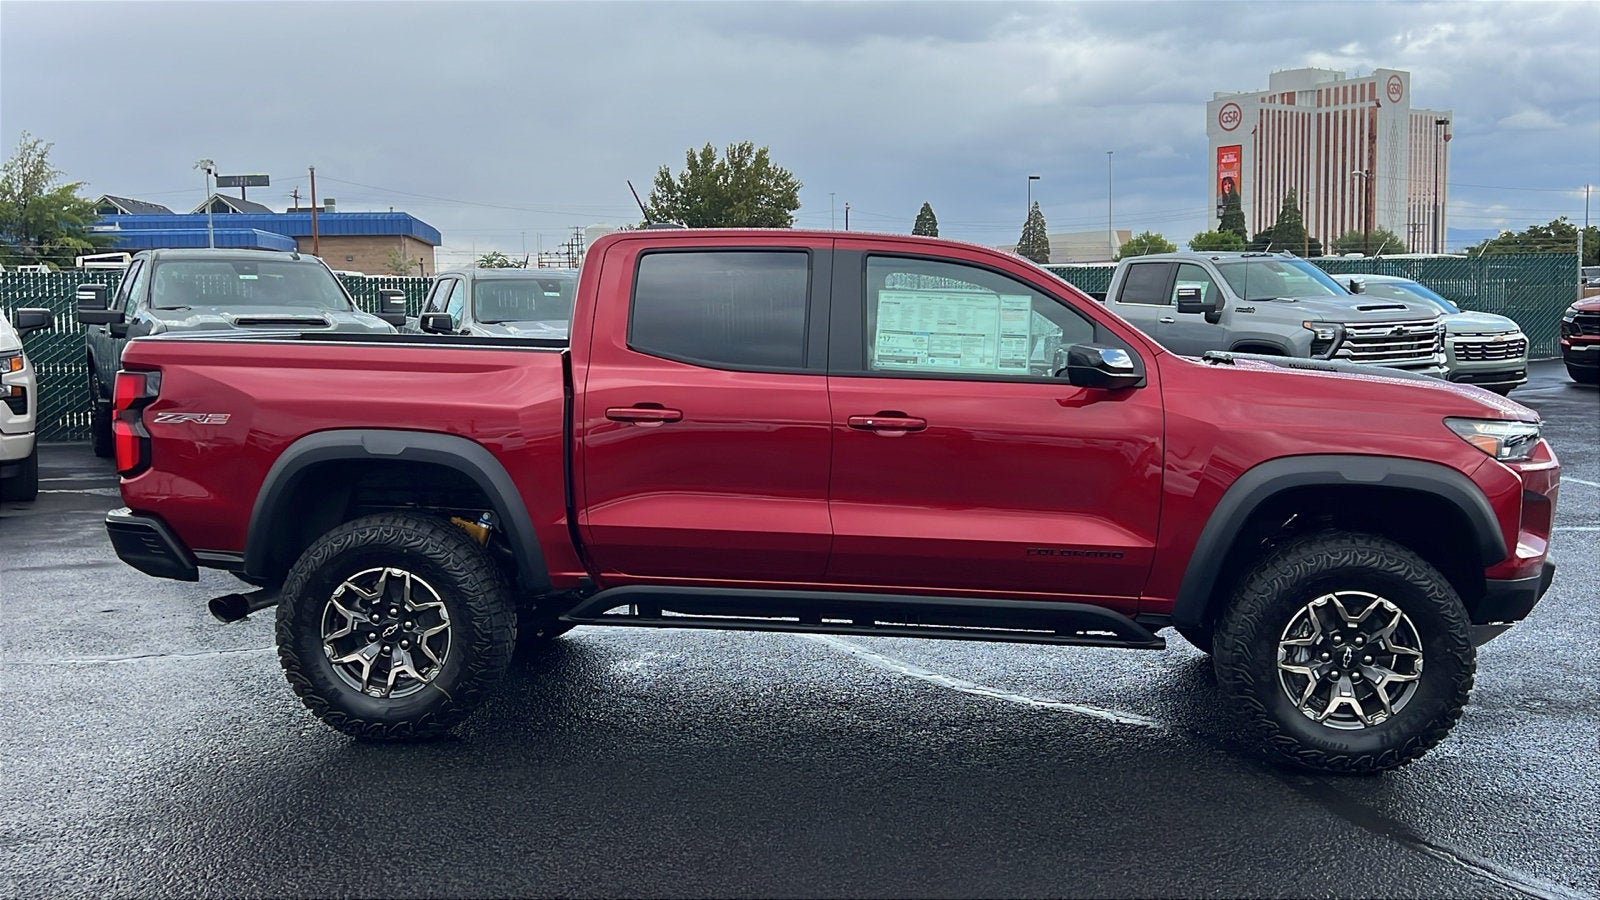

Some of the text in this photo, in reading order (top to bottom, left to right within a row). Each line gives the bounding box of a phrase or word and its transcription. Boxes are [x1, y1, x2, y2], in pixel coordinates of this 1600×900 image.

[1389, 83, 1401, 94] GSR
[1222, 111, 1238, 123] GSR
[153, 412, 231, 424] ZR2
[1026, 548, 1124, 558] COLORADO
